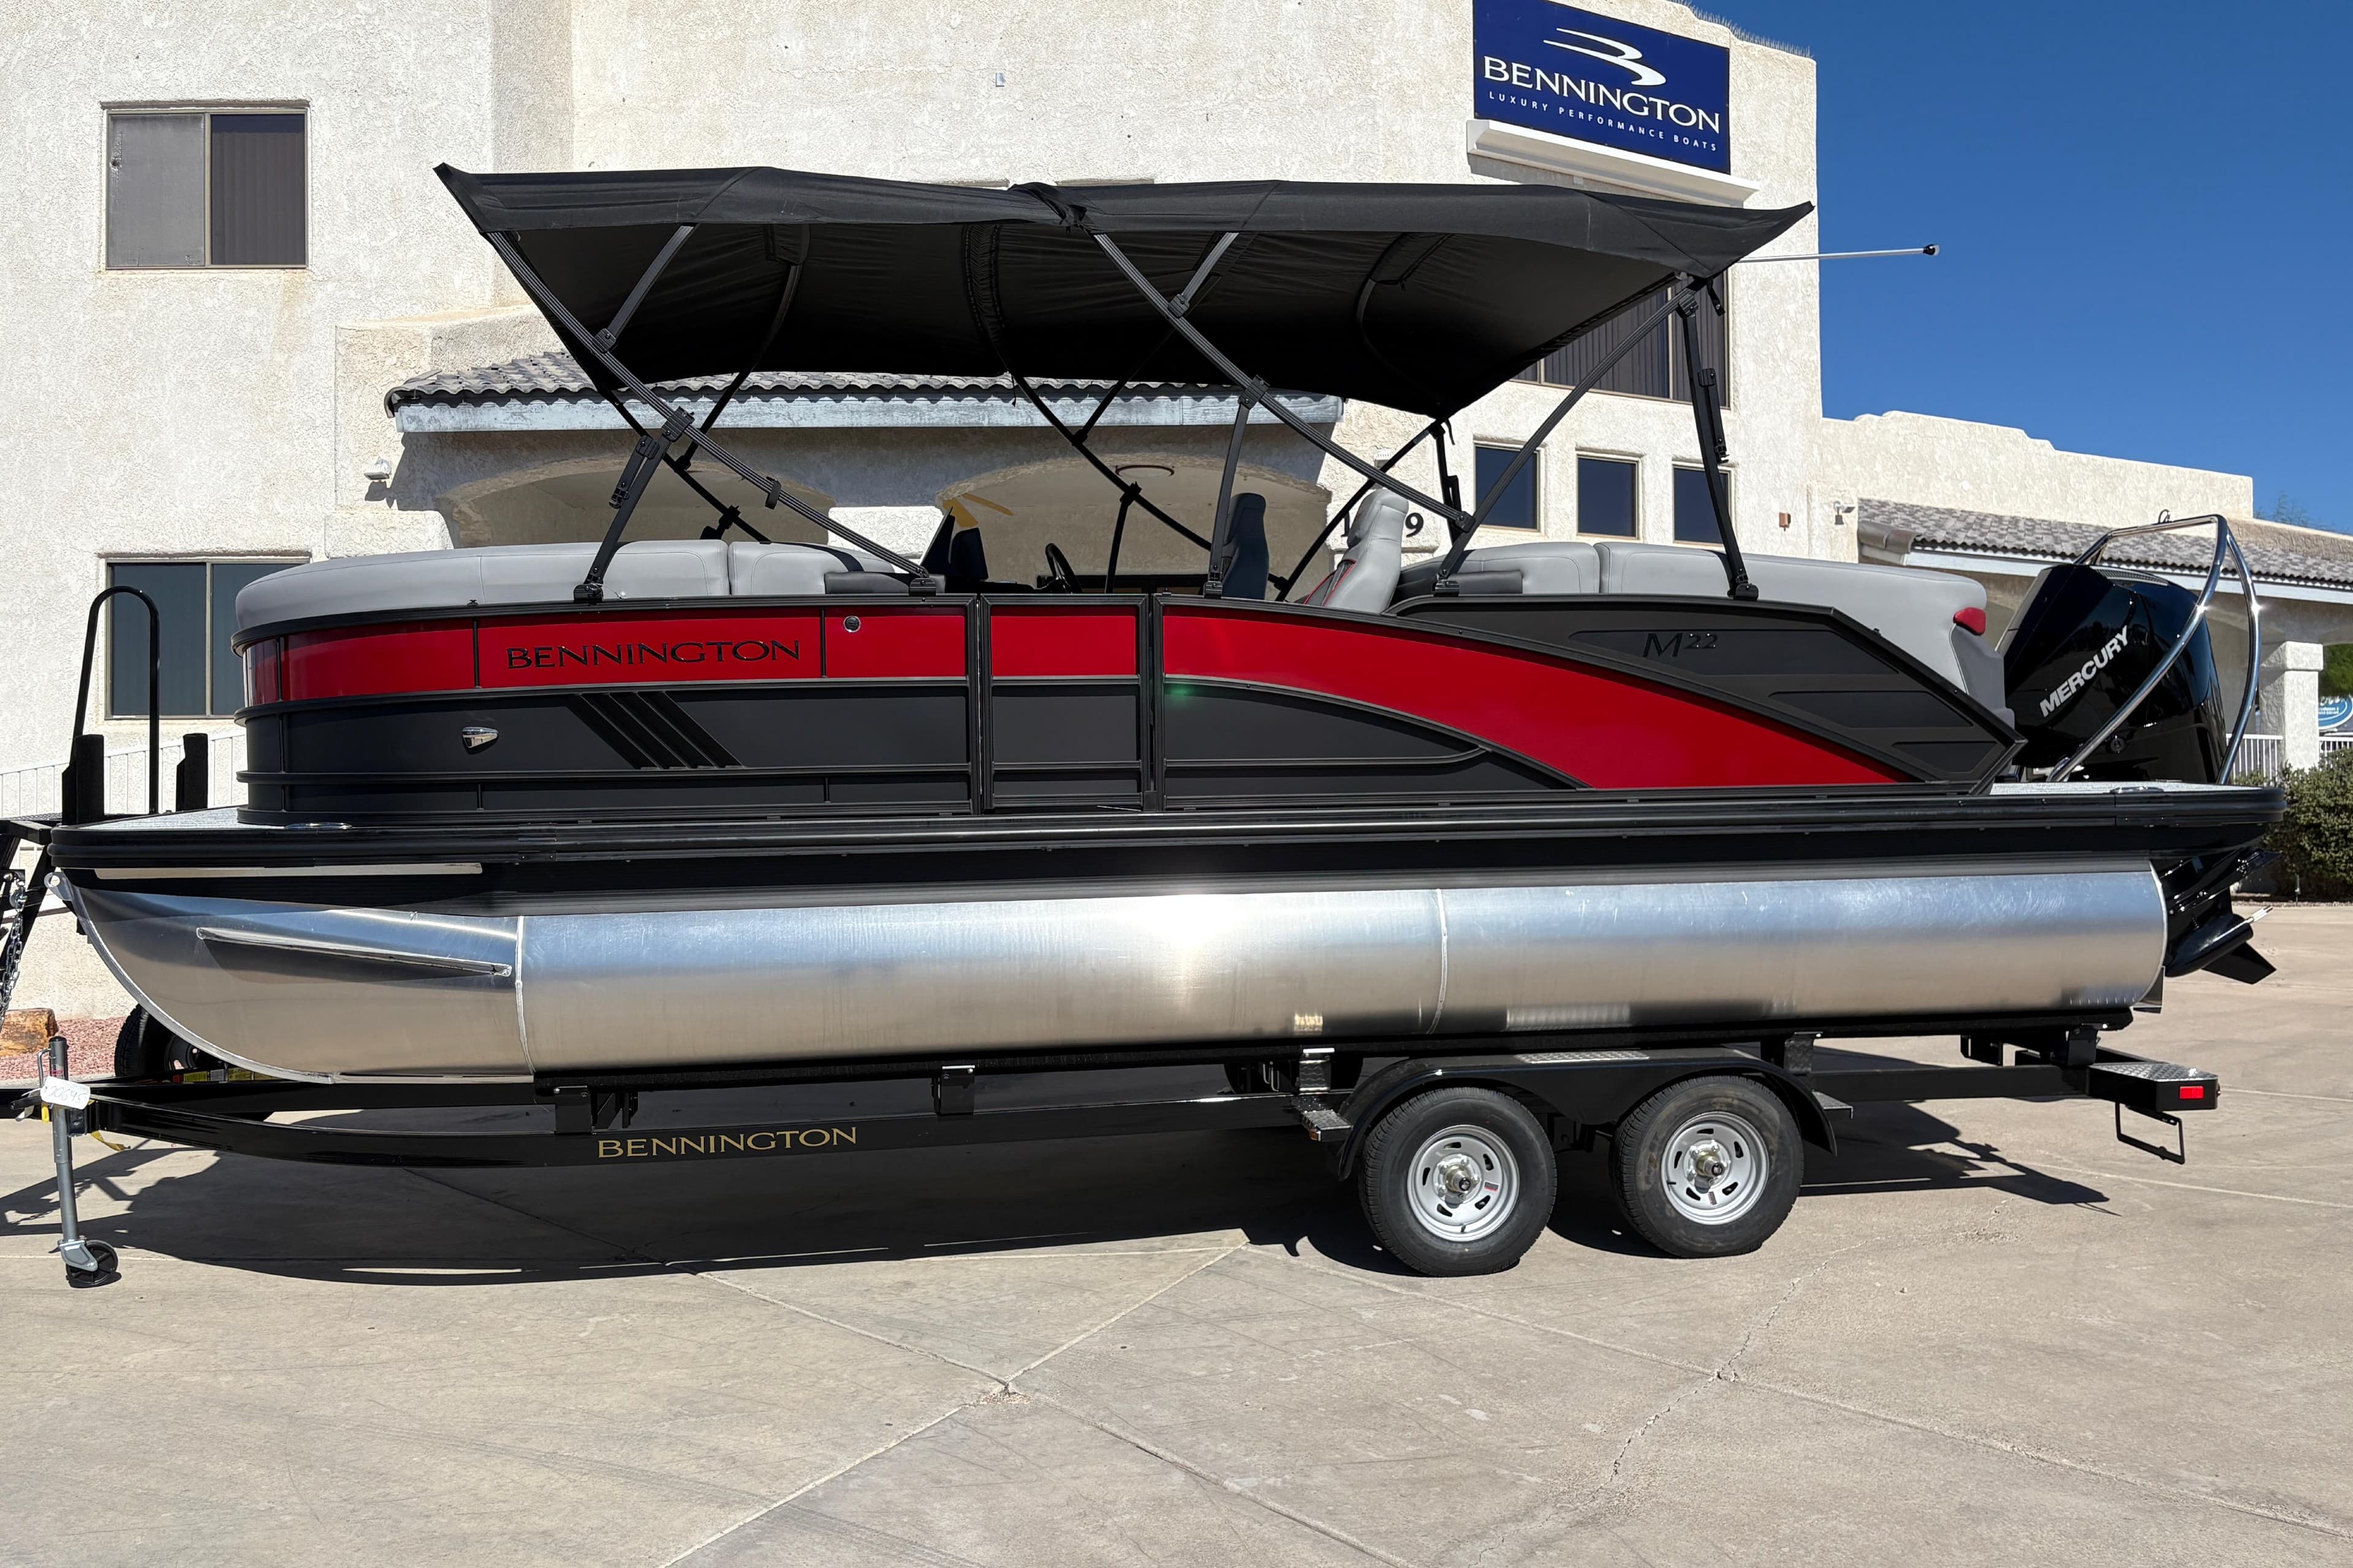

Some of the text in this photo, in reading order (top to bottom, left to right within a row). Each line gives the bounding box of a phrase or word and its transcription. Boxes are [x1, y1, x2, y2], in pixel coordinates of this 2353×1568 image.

[1484, 56, 1719, 134] BENNINGTON
[1490, 91, 1716, 151] LUXURY PERFORMANCE BOATS
[507, 640, 800, 669] BENNINGTON
[2039, 625, 2129, 717] MERCURY
[598, 1127, 857, 1158] BENNINGTON
